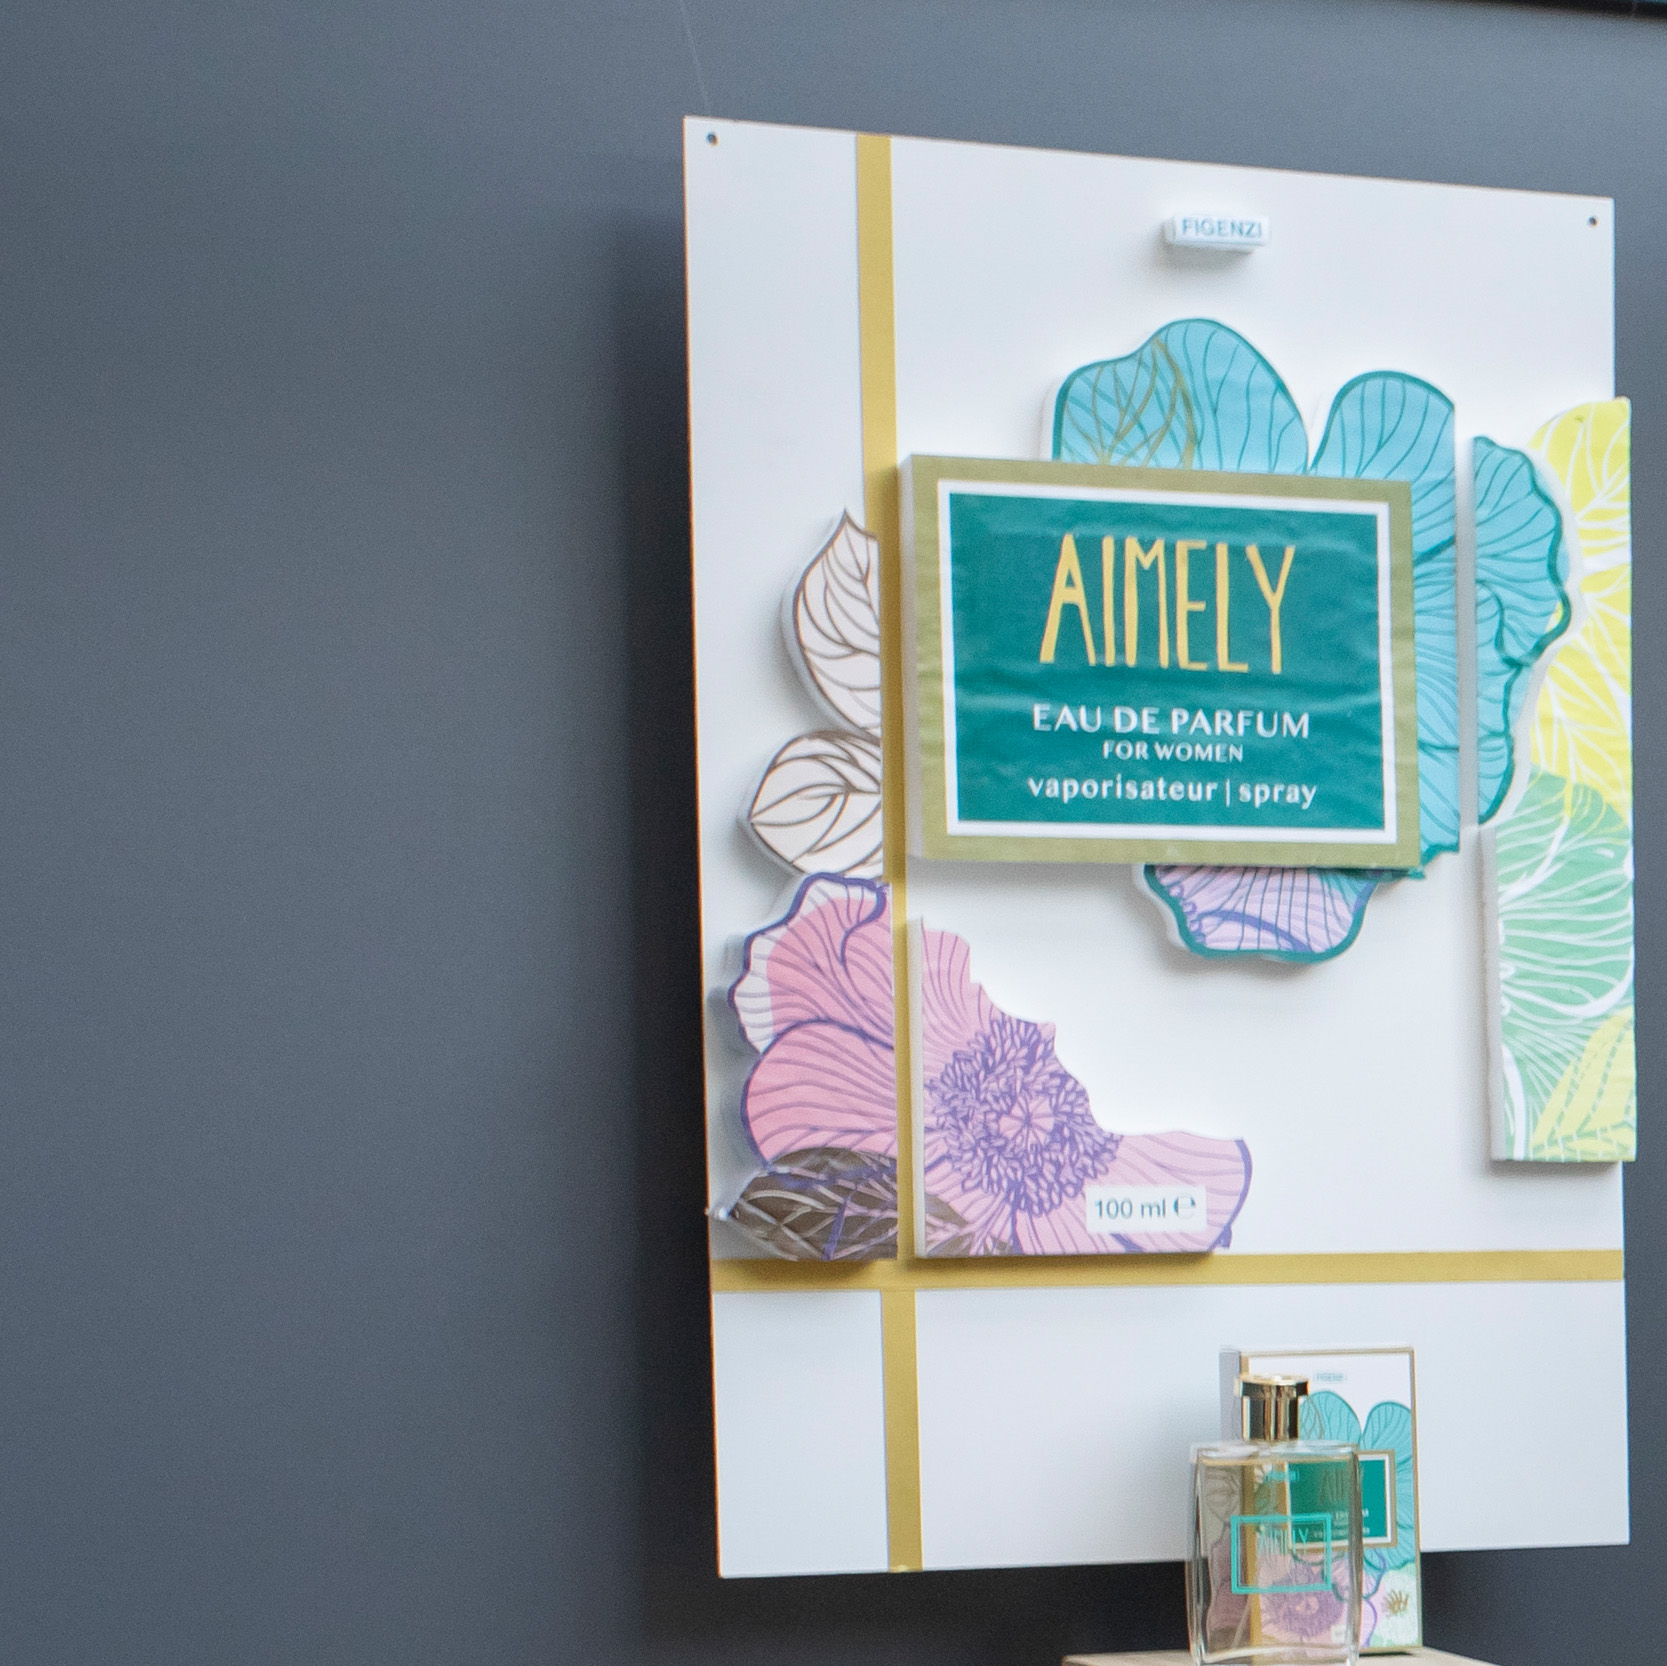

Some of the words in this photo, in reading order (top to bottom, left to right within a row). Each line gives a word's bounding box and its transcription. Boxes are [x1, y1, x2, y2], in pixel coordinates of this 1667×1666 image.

[1181, 217, 1263, 238] FIGENZI
[1039, 533, 1295, 674] AIMELY
[1032, 702, 1101, 733] EAU
[1113, 705, 1160, 735] DE
[1170, 707, 1310, 739] PARFUM
[1102, 739, 1149, 761] FOR
[1153, 741, 1244, 763] WOMEN
[1027, 773, 1218, 804] vaporisateur
[1237, 782, 1317, 810] spray
[1095, 1197, 1133, 1219] 100
[1140, 1197, 1166, 1218] ml
